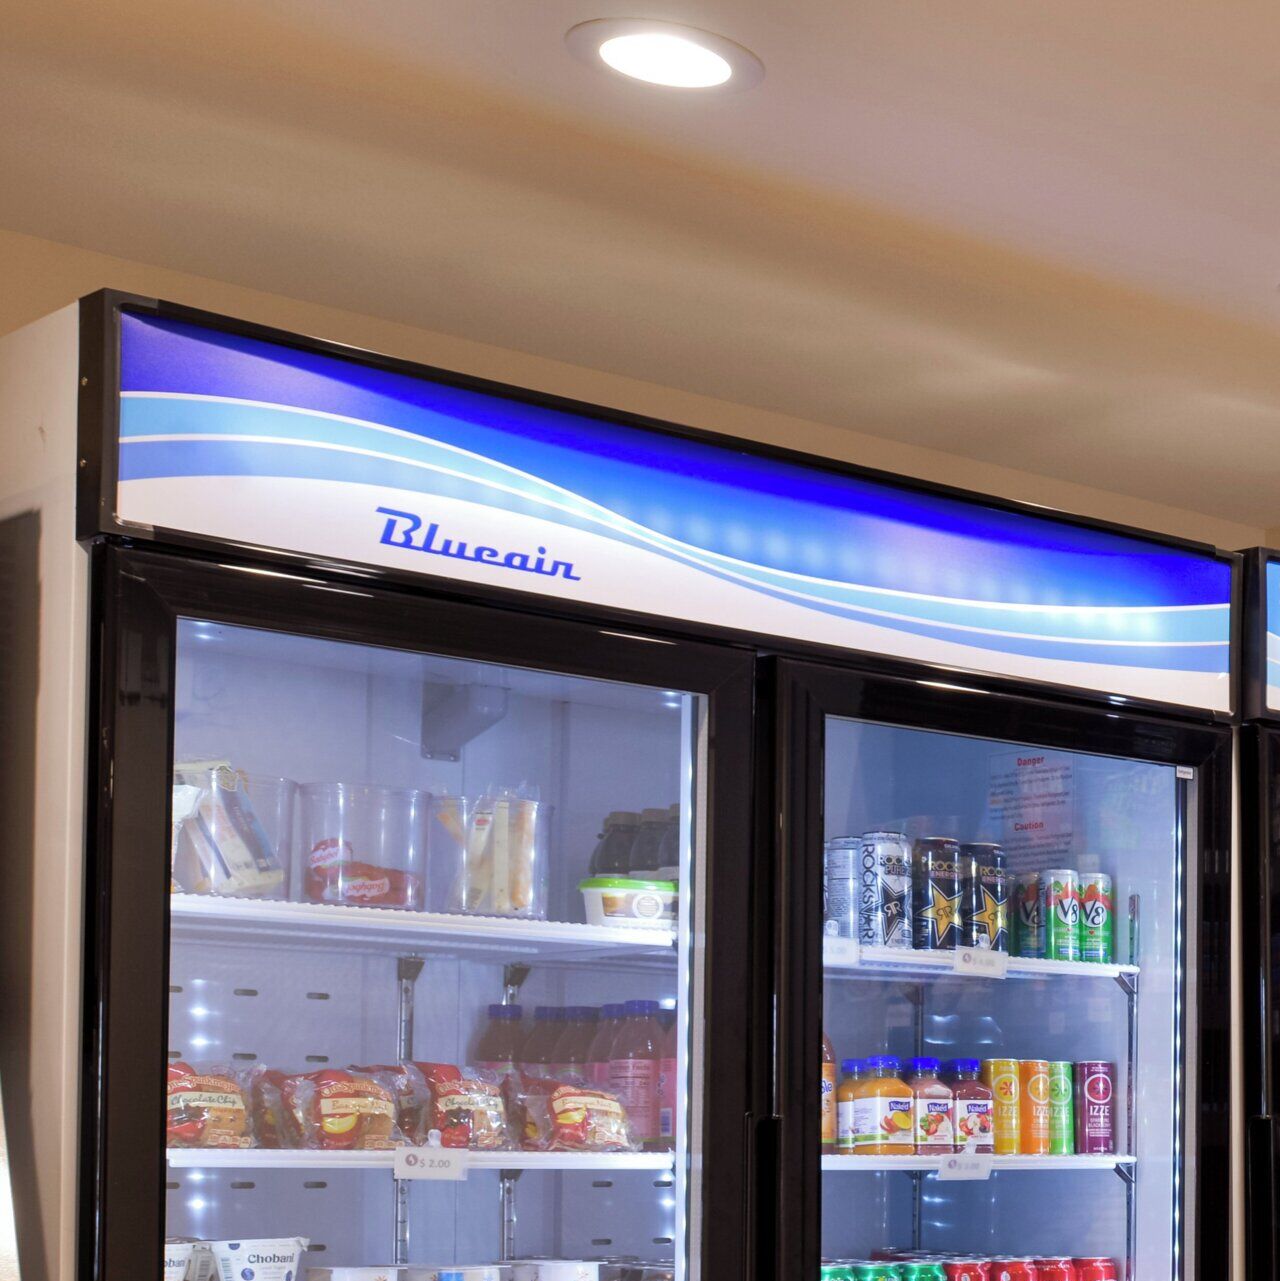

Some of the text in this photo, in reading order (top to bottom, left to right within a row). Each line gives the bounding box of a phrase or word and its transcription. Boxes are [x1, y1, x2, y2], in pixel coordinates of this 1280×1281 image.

[1017, 756, 1045, 766] Danger
[1014, 821, 1044, 831] Caution
[1081, 898, 1105, 926] V8
[1089, 1105, 1110, 1116] IZZE
[429, 1158, 450, 1168] 2.00
[248, 1253, 295, 1264] Chobani
